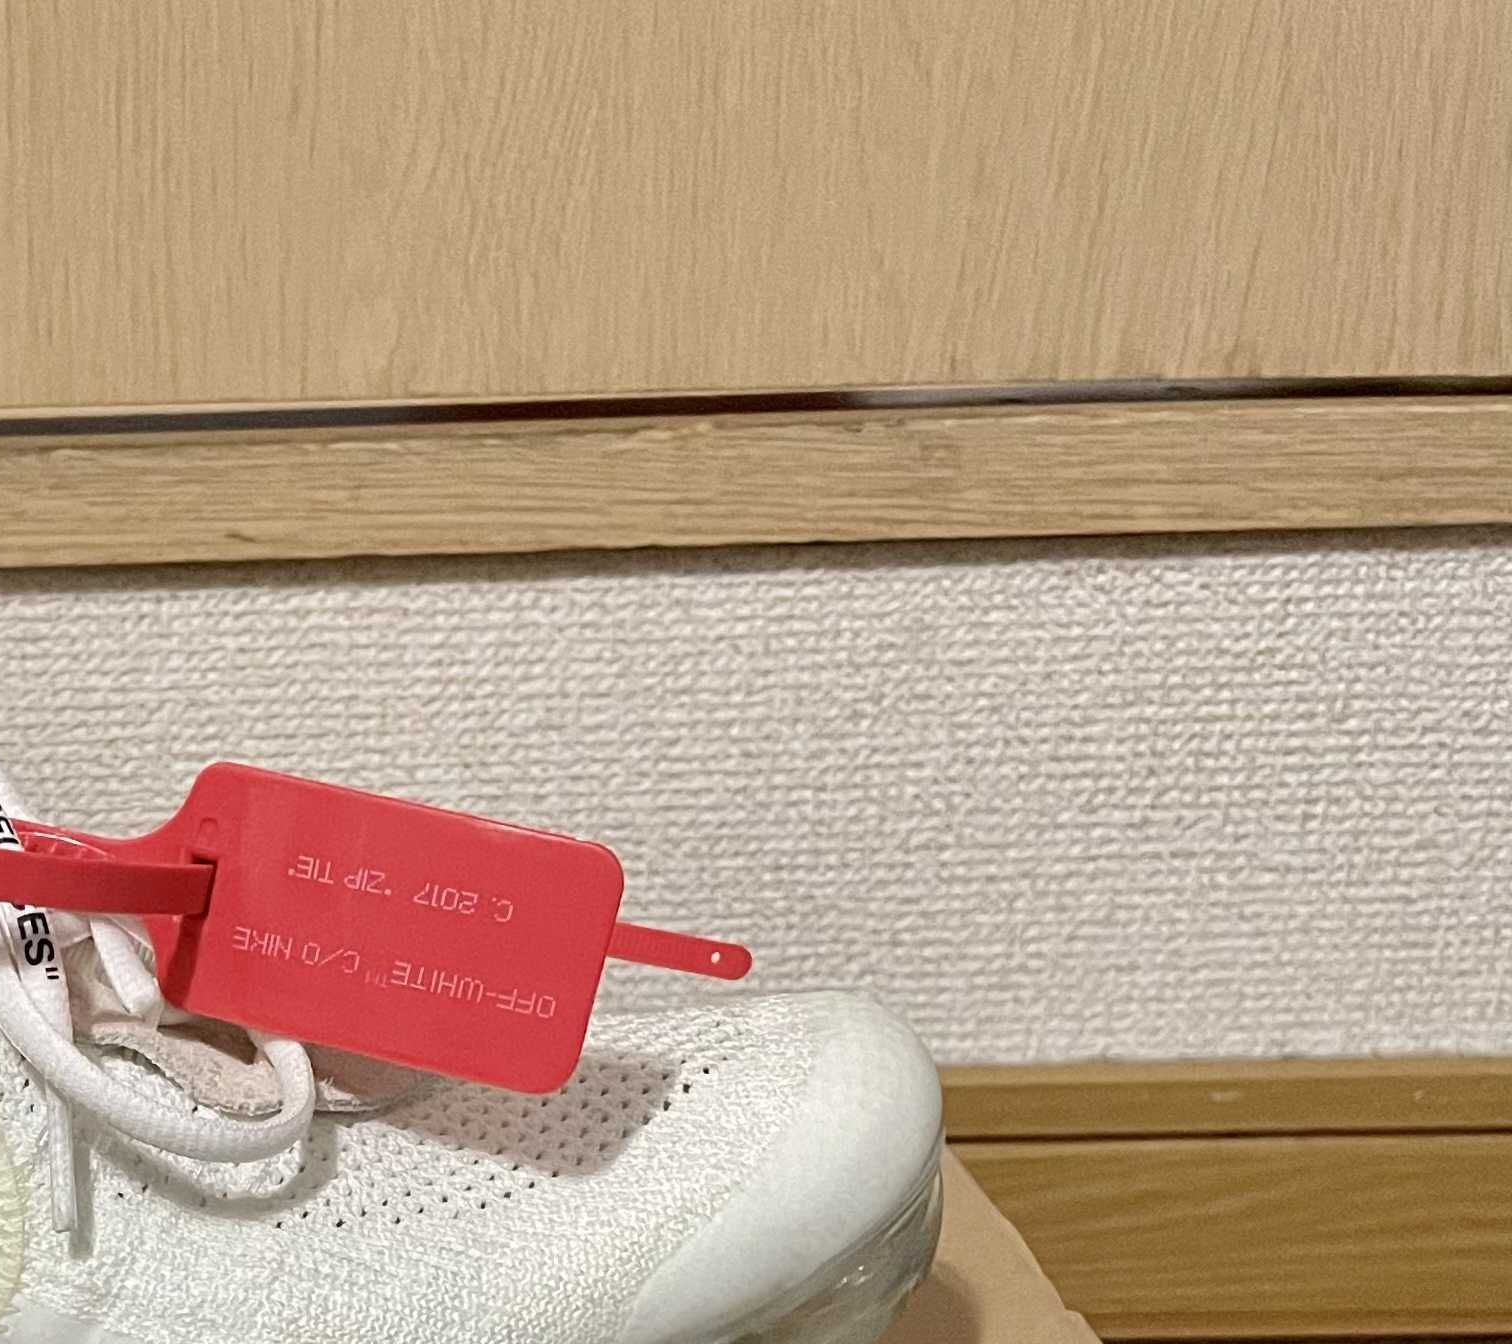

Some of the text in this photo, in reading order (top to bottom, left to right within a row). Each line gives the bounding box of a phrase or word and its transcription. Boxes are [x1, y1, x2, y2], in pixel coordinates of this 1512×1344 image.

[413, 881, 479, 914] 2017
[231, 925, 294, 961] NIKE
[301, 940, 361, 974] C/O
